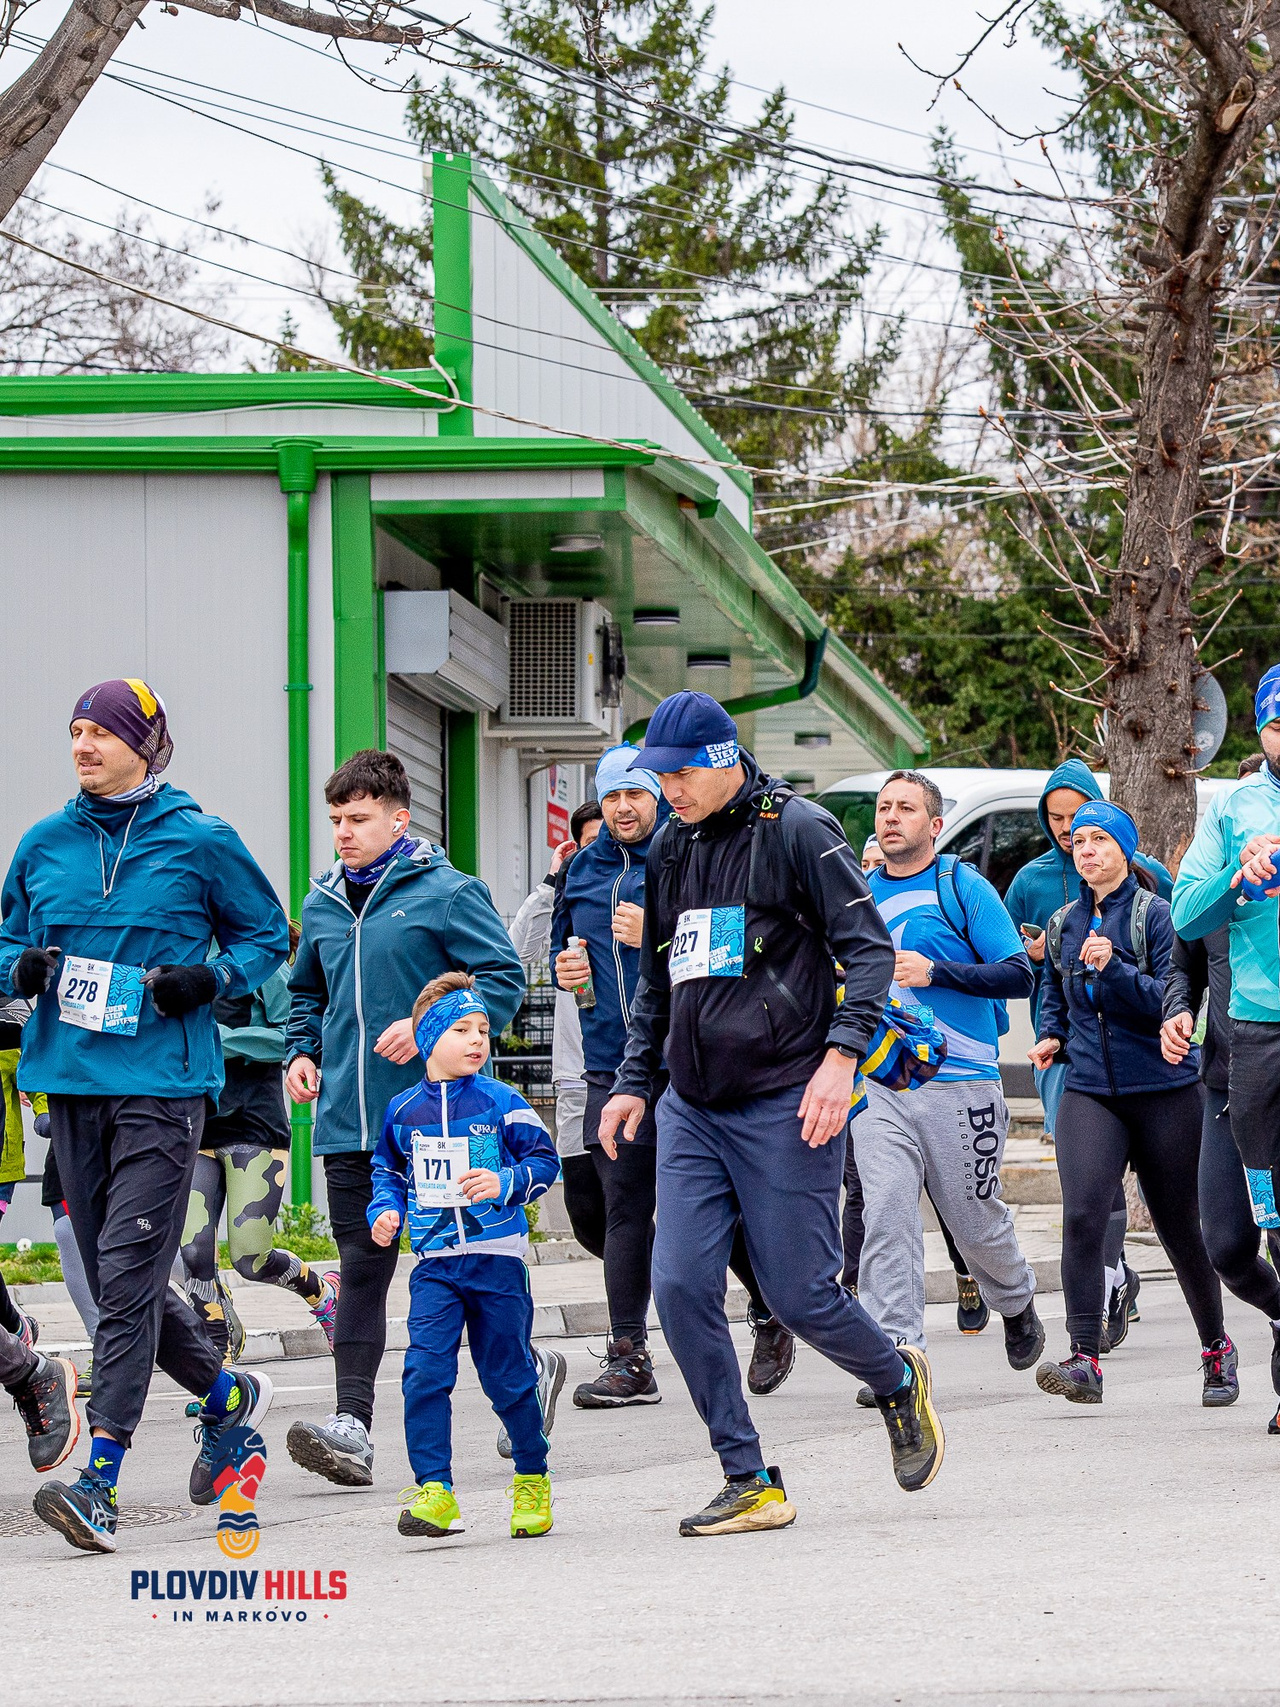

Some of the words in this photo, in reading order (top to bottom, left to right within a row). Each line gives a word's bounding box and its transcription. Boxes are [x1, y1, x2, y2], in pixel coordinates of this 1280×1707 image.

[673, 930, 698, 958] 227
[64, 977, 99, 1003] 278
[957, 1110, 970, 1151] HUGO
[964, 1162, 974, 1201] BOSS
[967, 1102, 999, 1200] BOSS
[423, 1159, 452, 1180] 171
